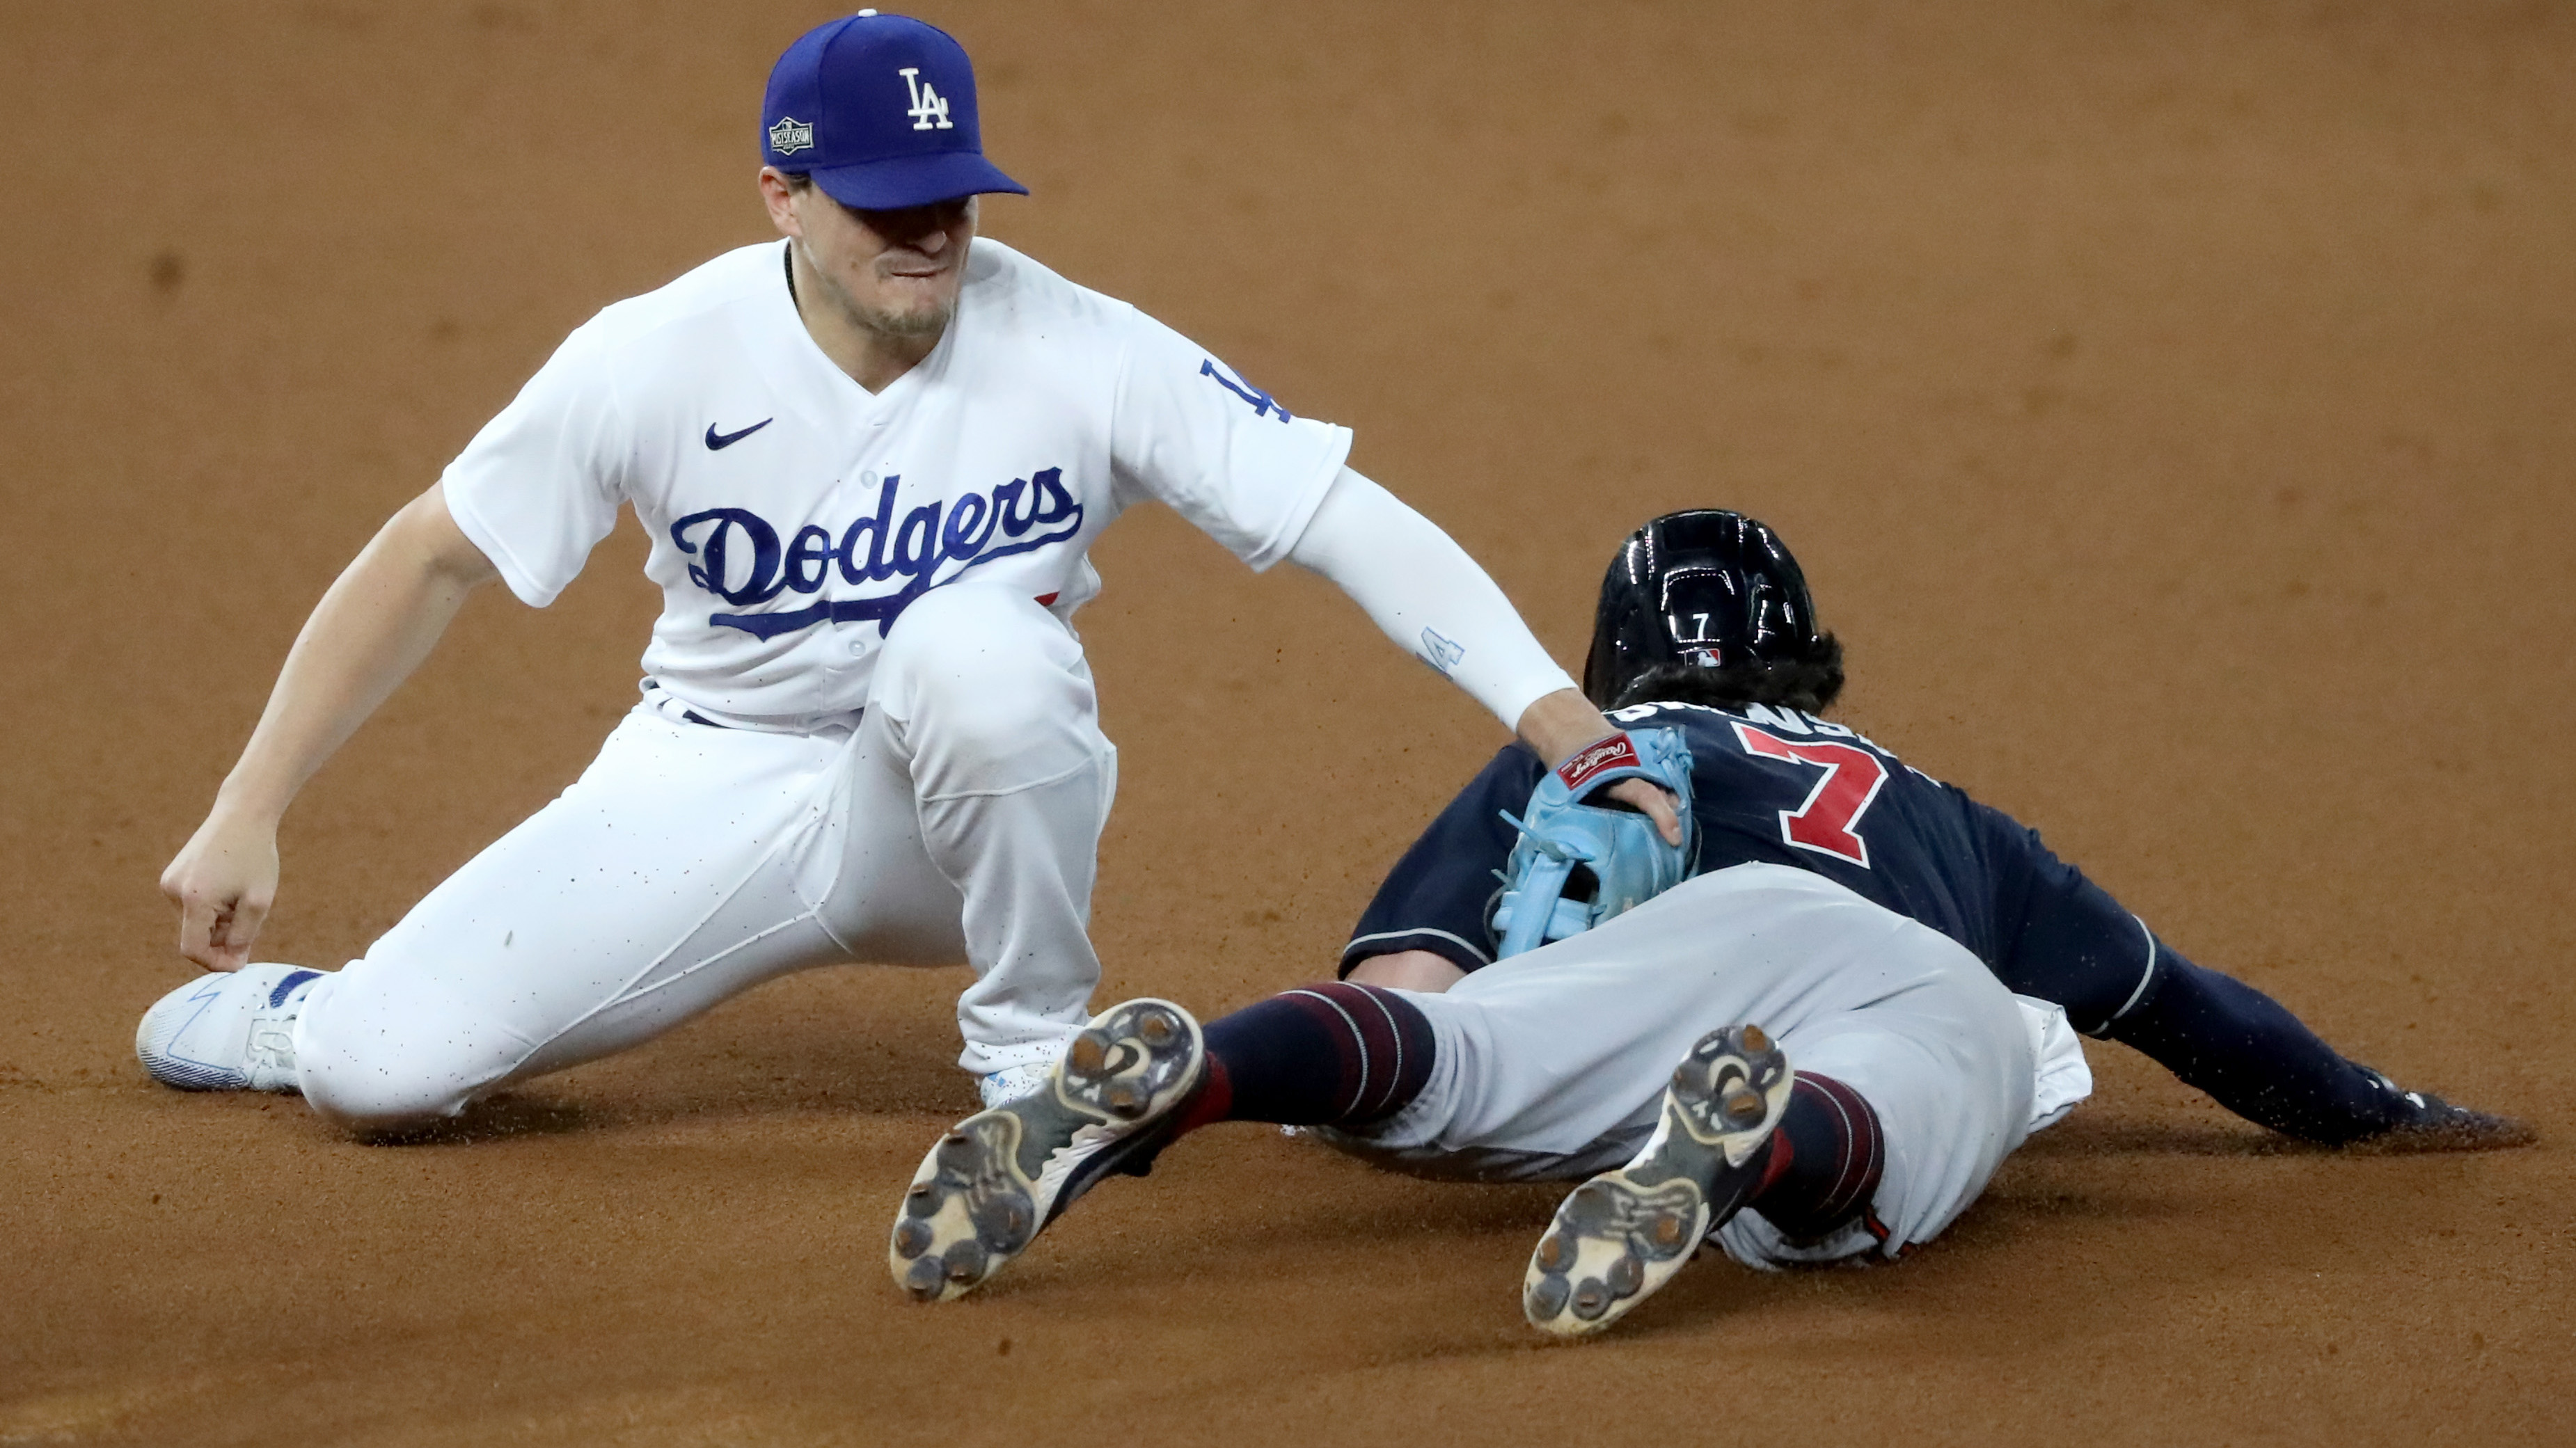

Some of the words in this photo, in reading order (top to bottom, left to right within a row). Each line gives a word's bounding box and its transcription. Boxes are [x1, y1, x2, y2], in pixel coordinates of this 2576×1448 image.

[899, 67, 953, 131] LA
[670, 467, 1083, 641] Dodgers
[1692, 613, 1709, 641] 7
[1570, 742, 1627, 778] Rawlings
[1730, 719, 1888, 869] 7
